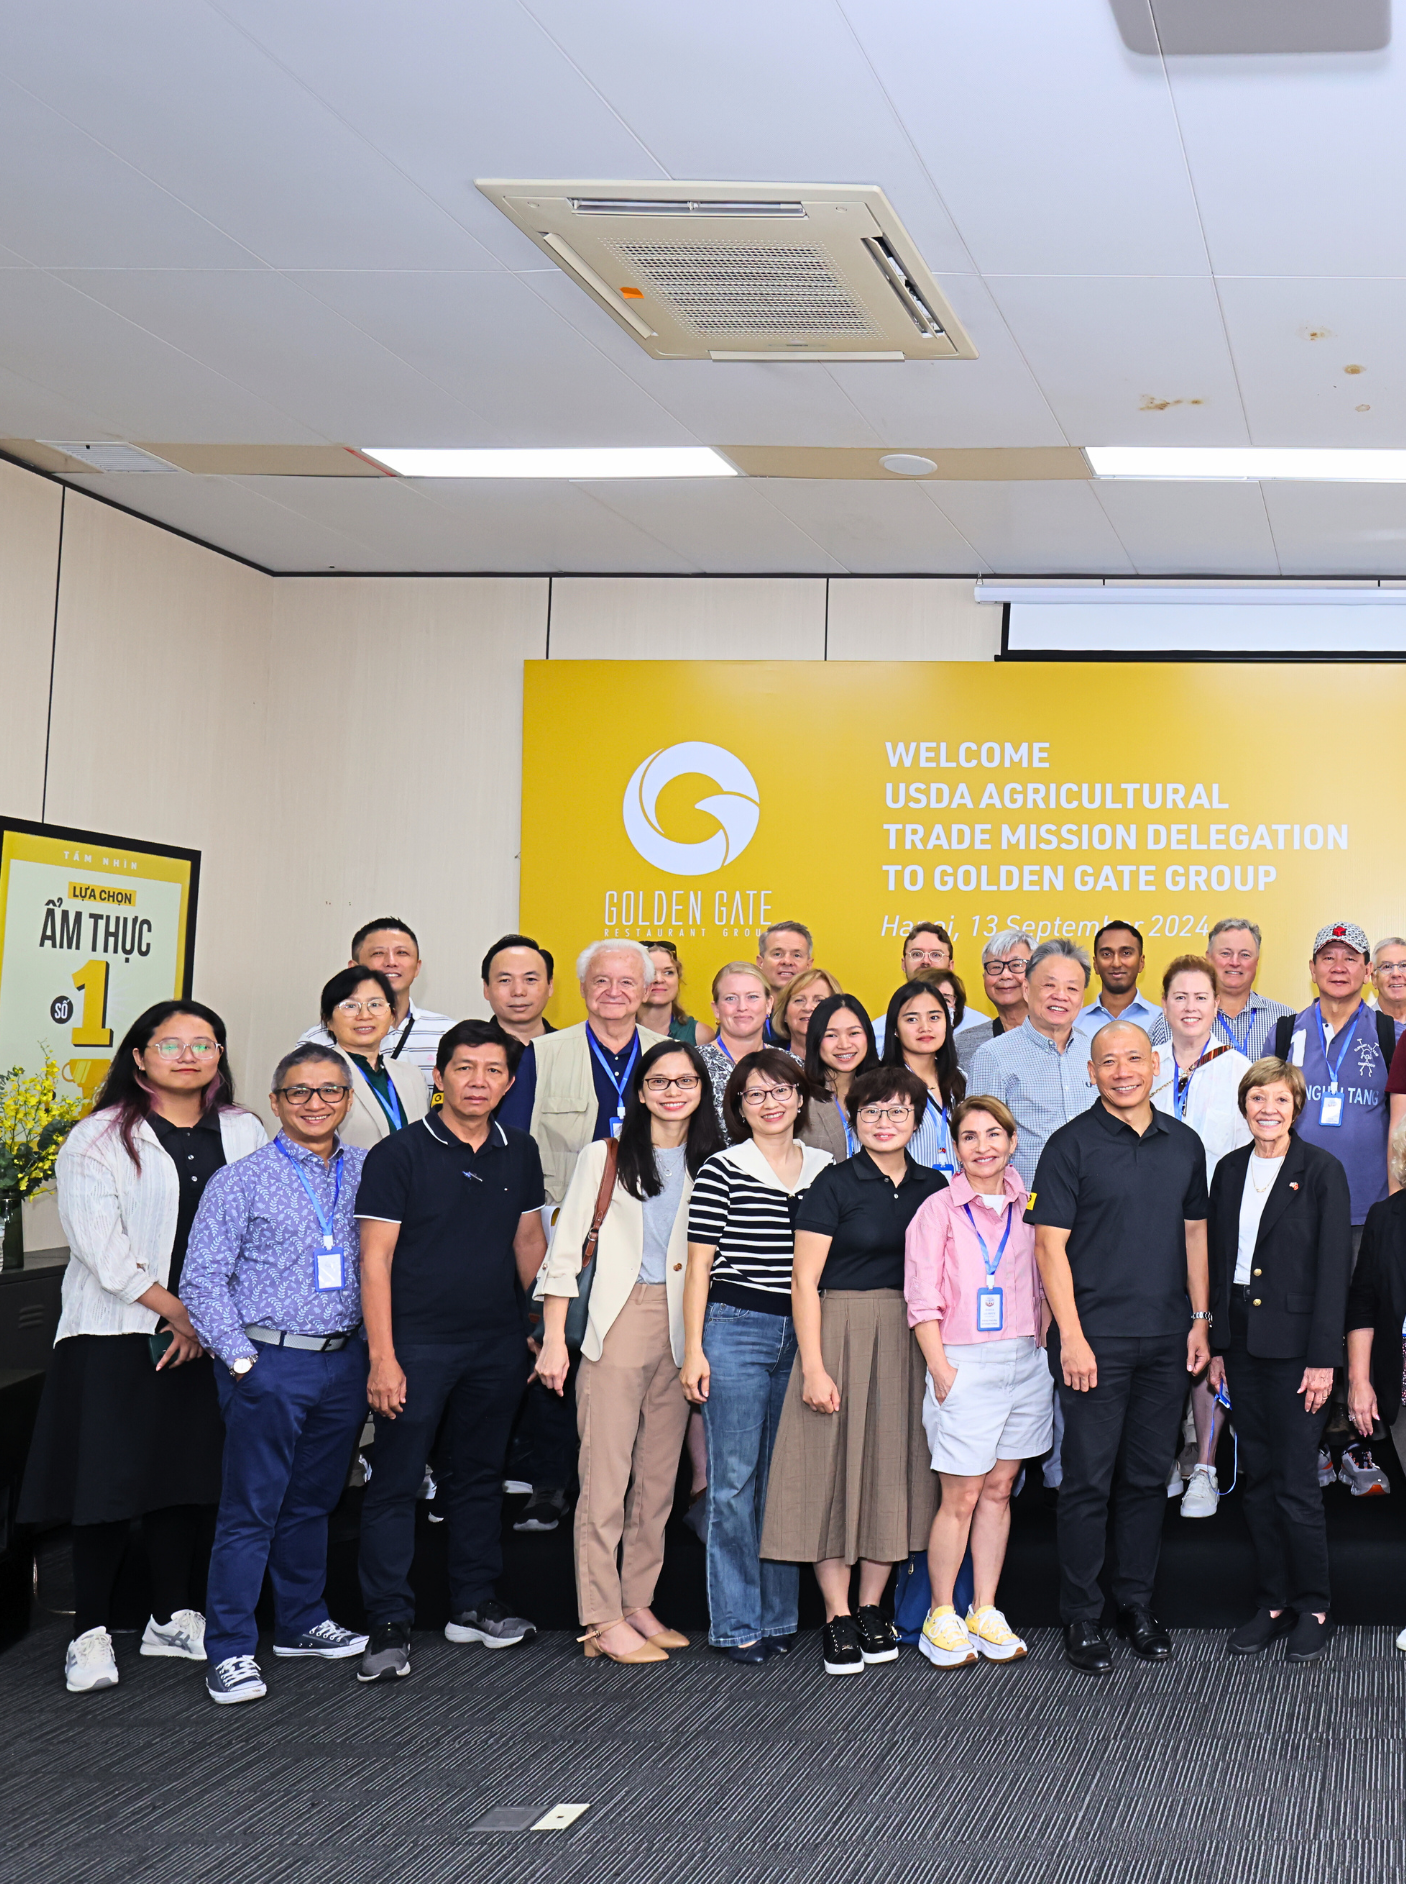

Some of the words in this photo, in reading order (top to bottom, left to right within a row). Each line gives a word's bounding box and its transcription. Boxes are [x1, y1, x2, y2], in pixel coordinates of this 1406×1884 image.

[885, 742, 1049, 767] WELCOME
[886, 783, 973, 808] USDA
[979, 783, 1229, 809] AGRICULTURAL
[883, 824, 991, 849] TRADE
[1002, 824, 1136, 850] MISSION
[1148, 824, 1348, 850] DELEGATION
[882, 865, 924, 891] TO
[934, 865, 1064, 891] GOLDEN
[1075, 865, 1156, 891] GATE
[1166, 865, 1277, 891] GROUP
[73, 886, 96, 901] LỰA
[99, 890, 132, 906] CHỌN
[602, 888, 702, 926] GOLDEN
[712, 888, 774, 926] GATE
[39, 897, 83, 950] ẨM
[89, 913, 151, 963] THỰC
[602, 927, 708, 938] RESTAURANT
[720, 927, 763, 938] GROU
[880, 914, 960, 942] Hai,
[971, 914, 999, 937] 13
[1149, 915, 1208, 936] 2024
[54, 999, 70, 1019] SỐ
[71, 959, 114, 1047] 1
[1348, 1087, 1379, 1105] TANG
